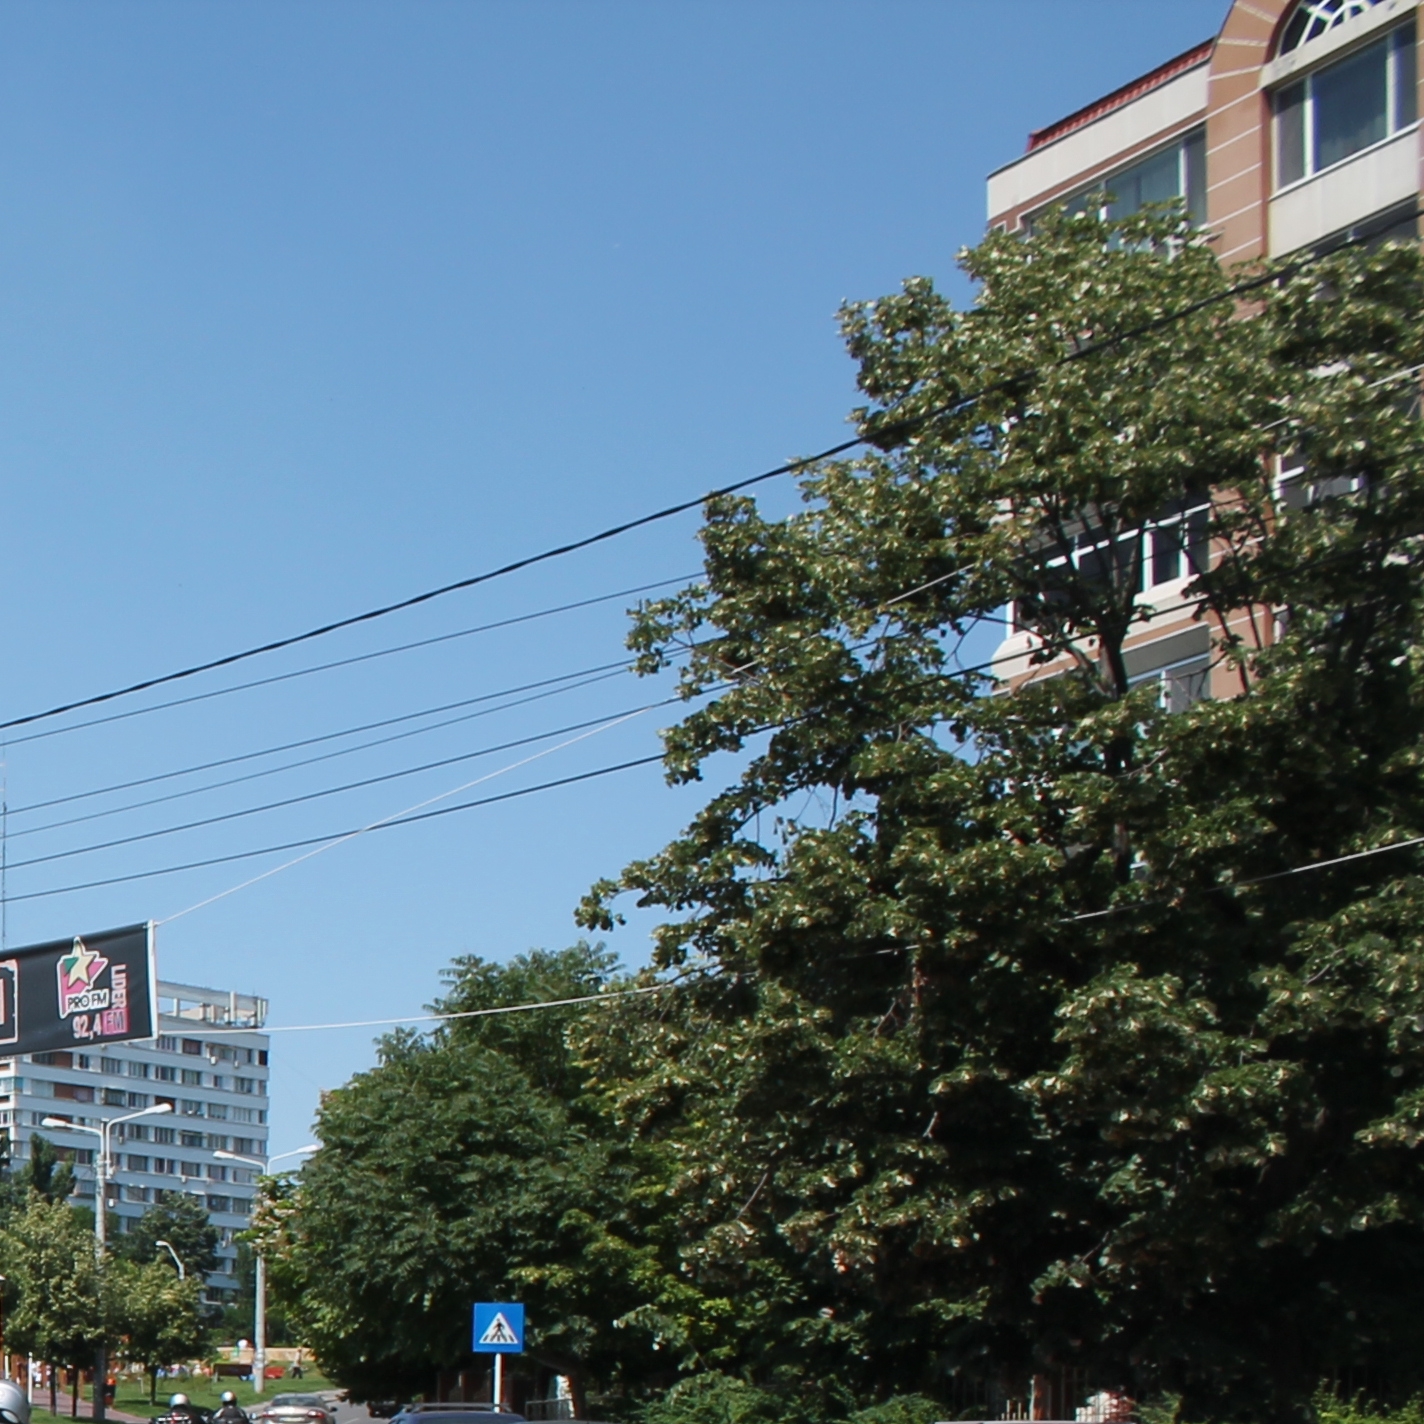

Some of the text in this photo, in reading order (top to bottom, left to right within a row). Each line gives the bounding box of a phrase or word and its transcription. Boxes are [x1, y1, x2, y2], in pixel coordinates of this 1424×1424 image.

[67, 992, 107, 1009] PRO FM
[72, 1013, 102, 1040] 92,4
